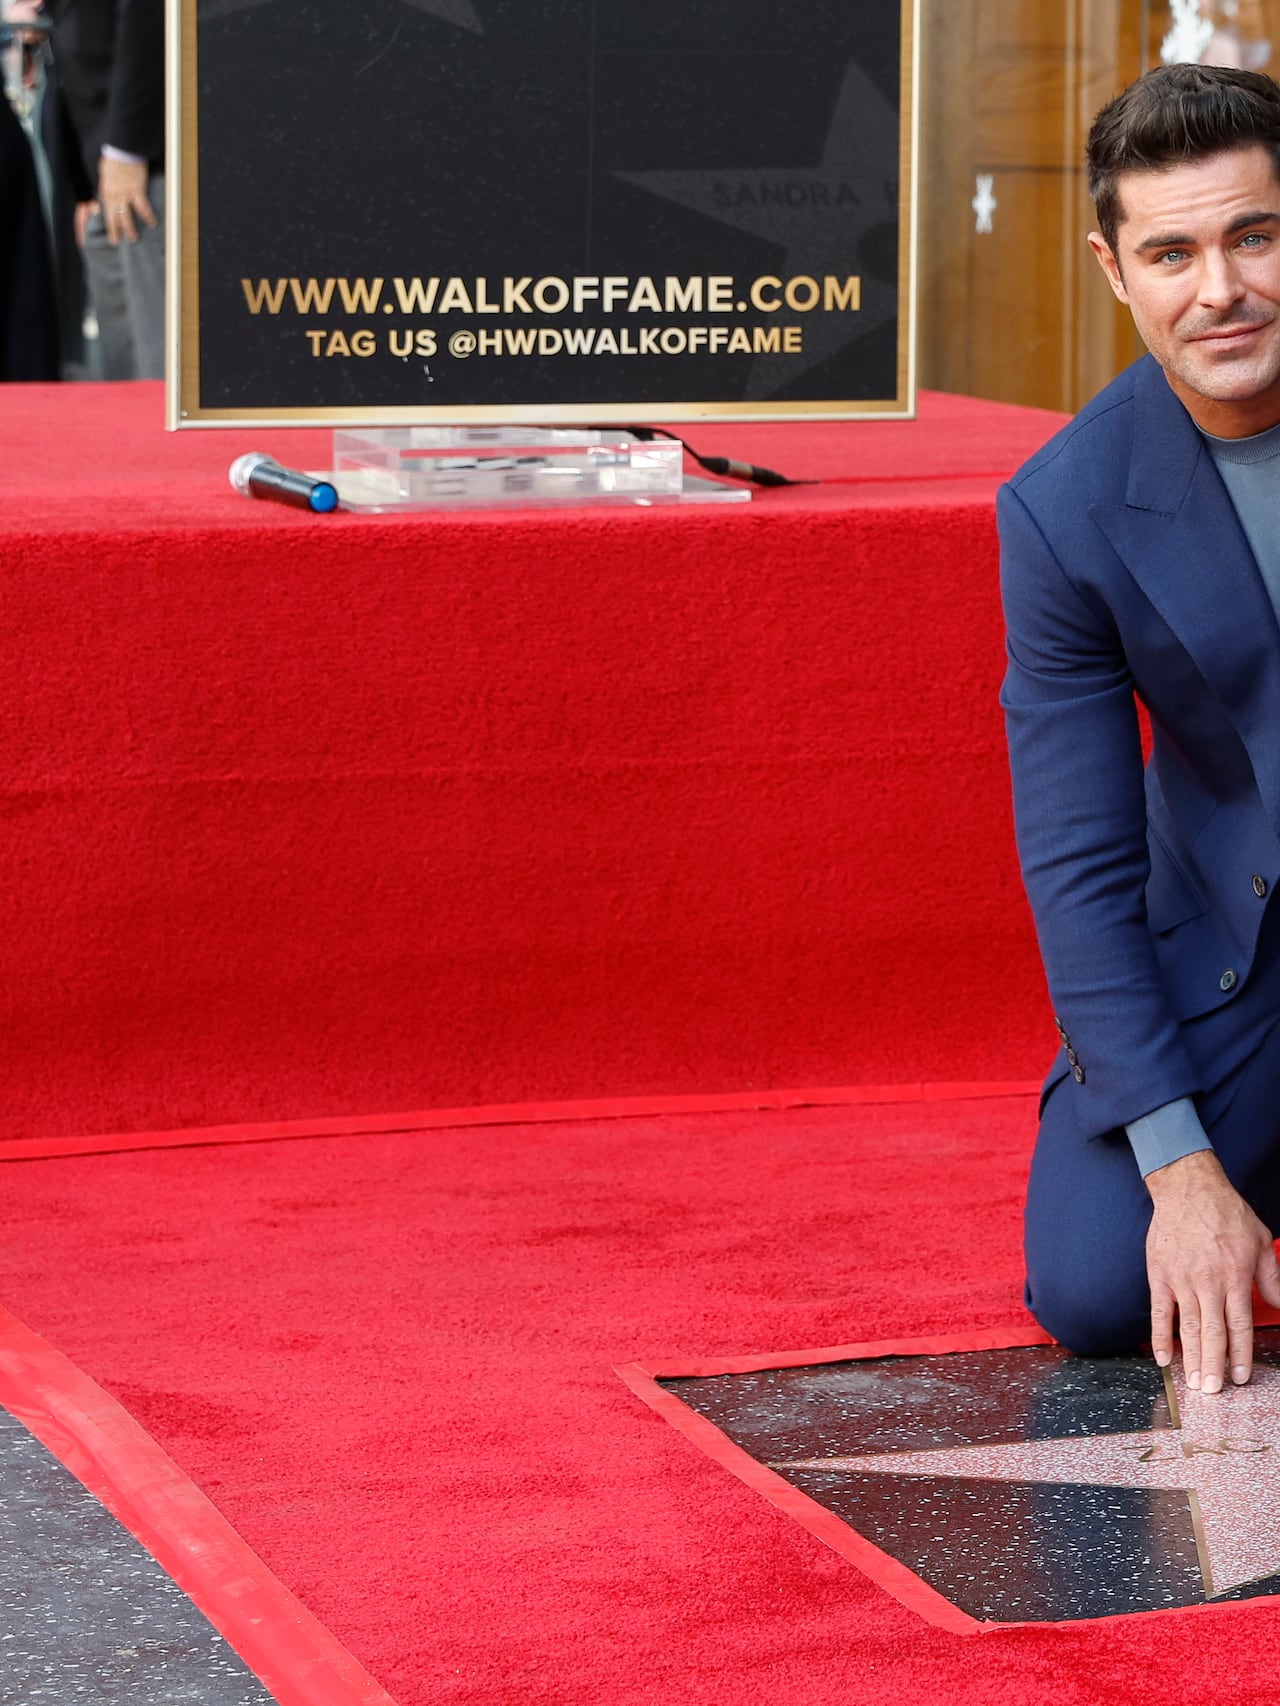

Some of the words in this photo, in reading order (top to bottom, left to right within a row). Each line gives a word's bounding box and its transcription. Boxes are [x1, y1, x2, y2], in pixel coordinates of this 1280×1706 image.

[712, 182, 861, 210] SANDRA
[241, 275, 861, 314] WWW.WALKOFFAME.COM
[305, 329, 376, 357] TAG
[388, 328, 438, 357] US
[448, 326, 803, 359] @HWDWALKOFFAME
[1122, 1437, 1271, 1463] ZAC
